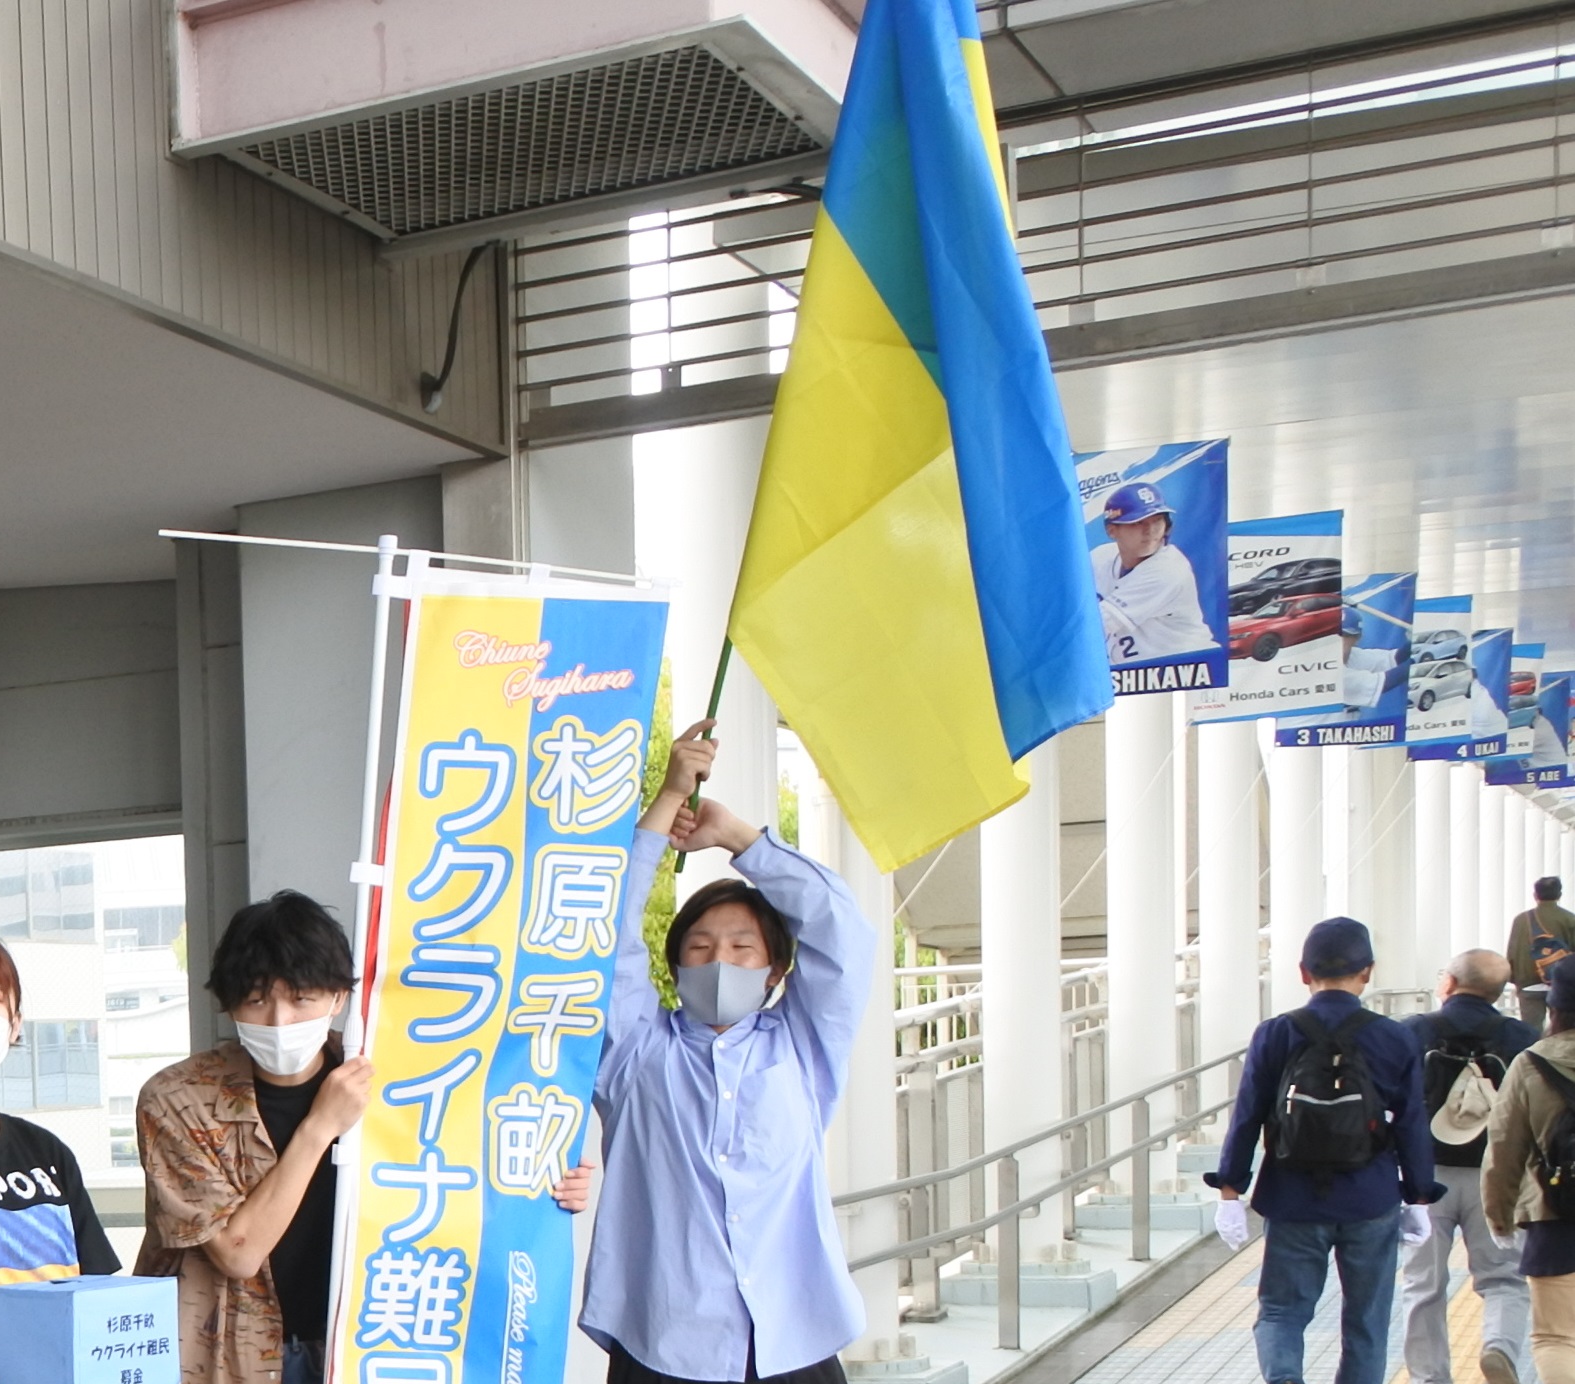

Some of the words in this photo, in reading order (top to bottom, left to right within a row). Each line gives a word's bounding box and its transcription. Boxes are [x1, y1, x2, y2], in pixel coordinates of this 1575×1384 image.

[1228, 547, 1290, 561] CORD
[453, 630, 552, 668] Chiune
[1118, 635, 1139, 658] 2
[1278, 660, 1338, 674] CIVIC
[503, 659, 635, 712] Sugihara
[1229, 687, 1274, 701] Honda
[1279, 686, 1310, 697] Cars
[1424, 721, 1447, 730] Cars
[1297, 729, 1310, 745] 3
[1316, 725, 1395, 744] TAKAHASHI
[1456, 744, 1467, 757] 4
[1475, 741, 1499, 756] UKAI
[1527, 772, 1535, 783] 5
[1539, 771, 1560, 782] ABE
[510, 1251, 538, 1342] Please
[91, 1337, 170, 1361] ウクライナ難民
